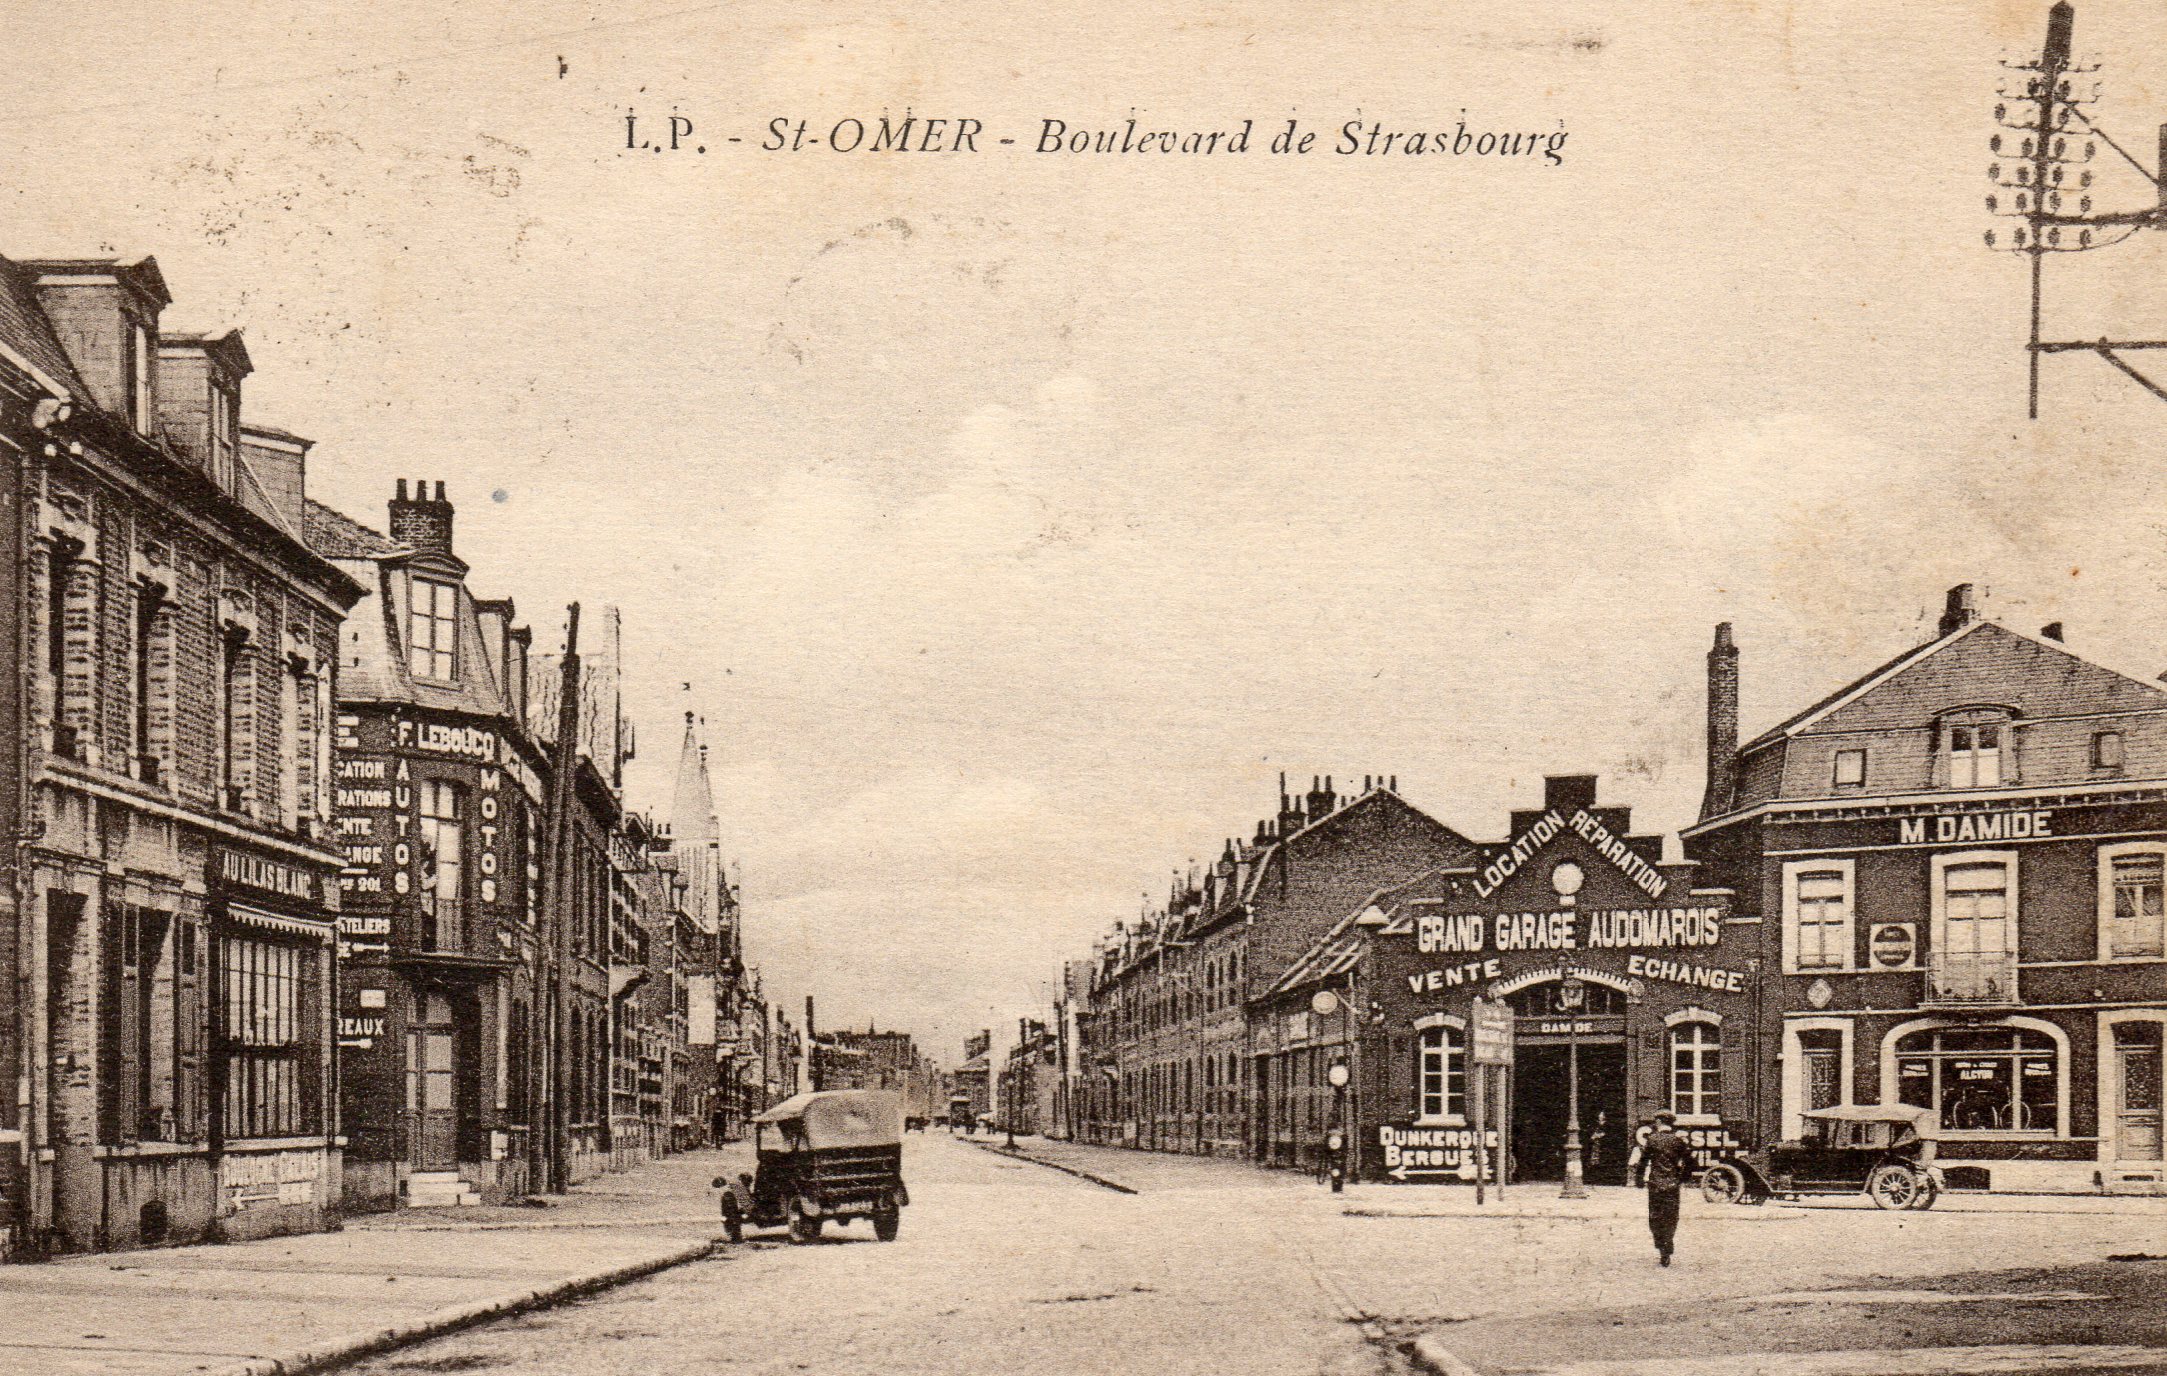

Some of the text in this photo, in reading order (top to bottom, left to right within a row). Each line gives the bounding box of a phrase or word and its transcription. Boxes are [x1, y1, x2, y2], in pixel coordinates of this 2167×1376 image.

[394, 757, 410, 894] AUTOS
[480, 767, 501, 903] MOTOS
[1901, 810, 2053, 844] M. DAMIDE
[1473, 809, 1566, 898] LOCATION
[1418, 907, 1720, 953] GRAND GARAGE AUDOMAROIS
[1408, 958, 1501, 993] VENTE
[1627, 955, 1744, 992] ECHANGE
[1379, 1125, 1498, 1149] DUNKERQUE
[1635, 1125, 1740, 1148] CSSEL
